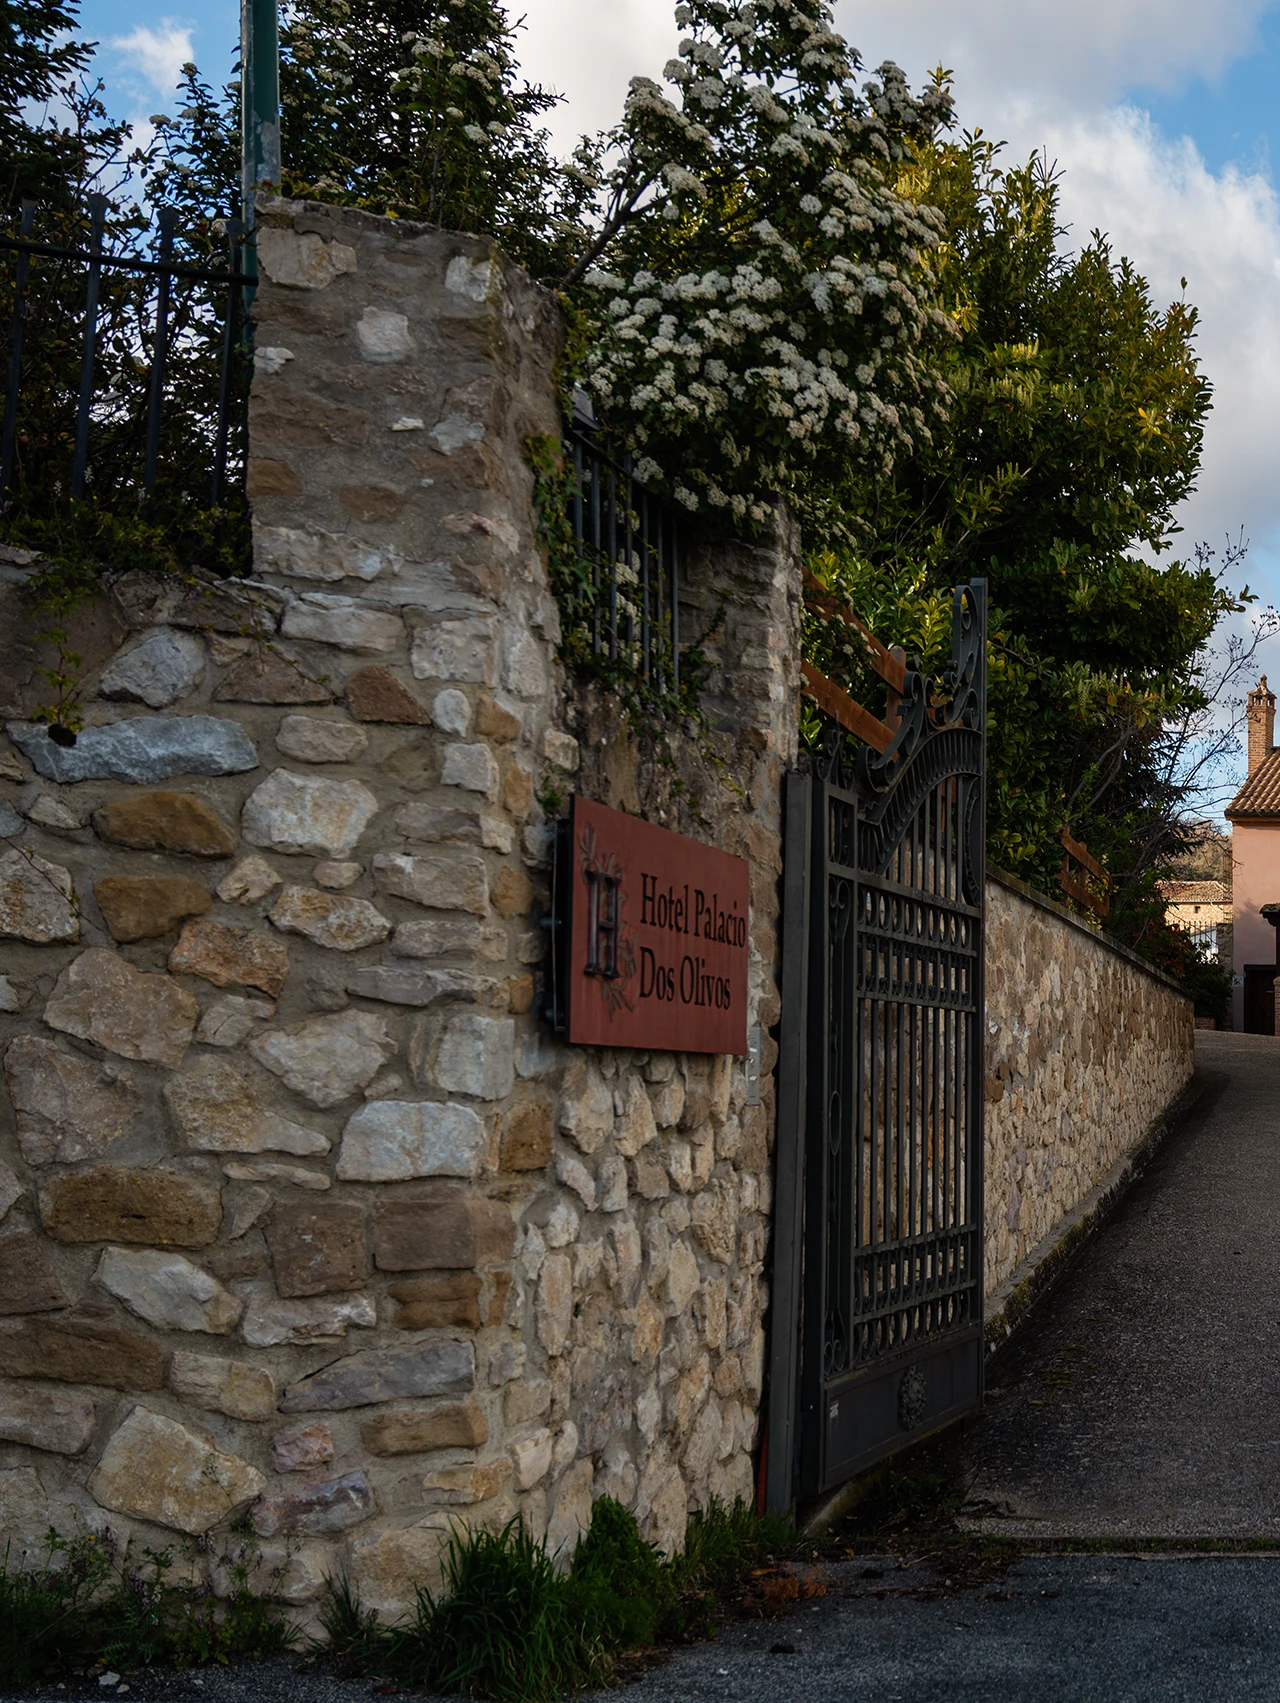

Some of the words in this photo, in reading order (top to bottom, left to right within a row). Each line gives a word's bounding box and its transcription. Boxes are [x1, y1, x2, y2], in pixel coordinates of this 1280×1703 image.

[640, 873, 689, 934] Hotel
[694, 888, 746, 948] Palacio
[639, 947, 675, 1002] Dos
[679, 955, 731, 1010] Olivos
